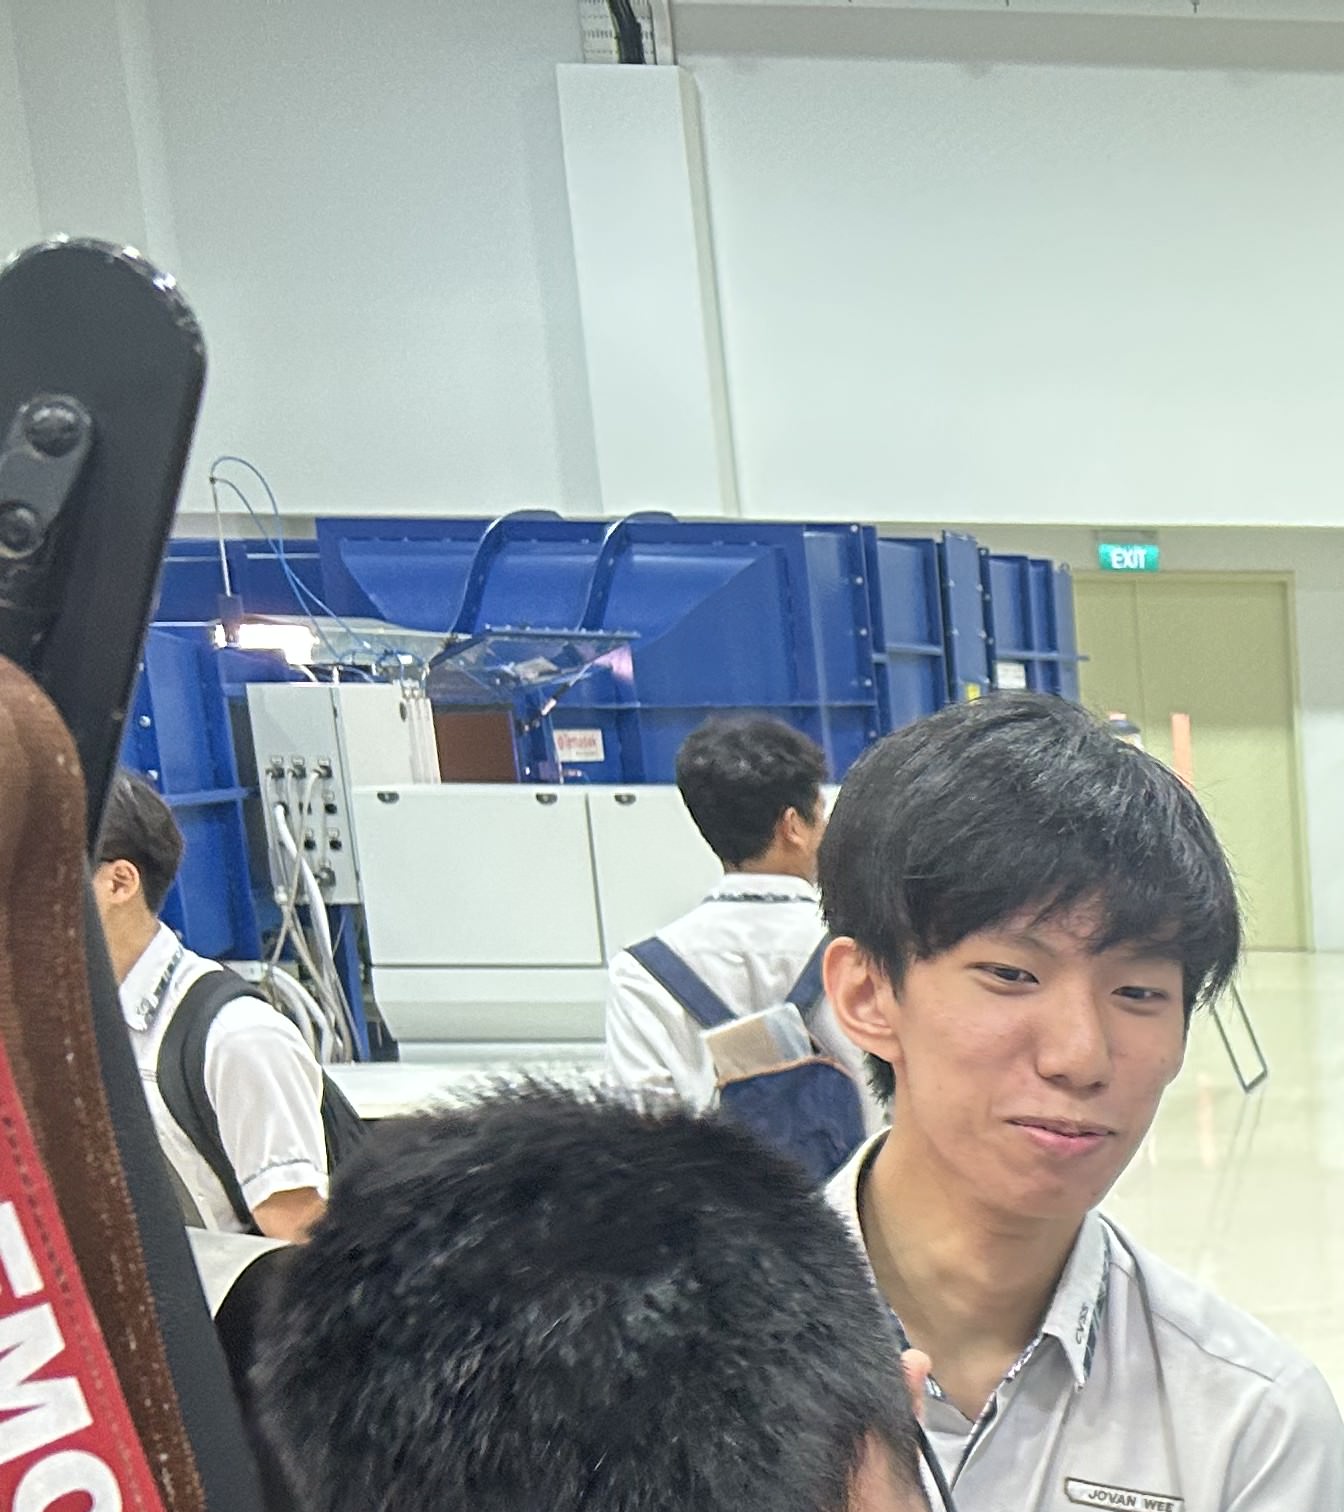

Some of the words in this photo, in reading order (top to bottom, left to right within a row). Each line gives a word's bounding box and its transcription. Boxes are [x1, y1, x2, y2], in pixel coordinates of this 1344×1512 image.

[1111, 547, 1147, 569] EXIT
[1088, 1490, 1137, 1506] JOVAN
[1144, 1499, 1174, 1512] WEE
